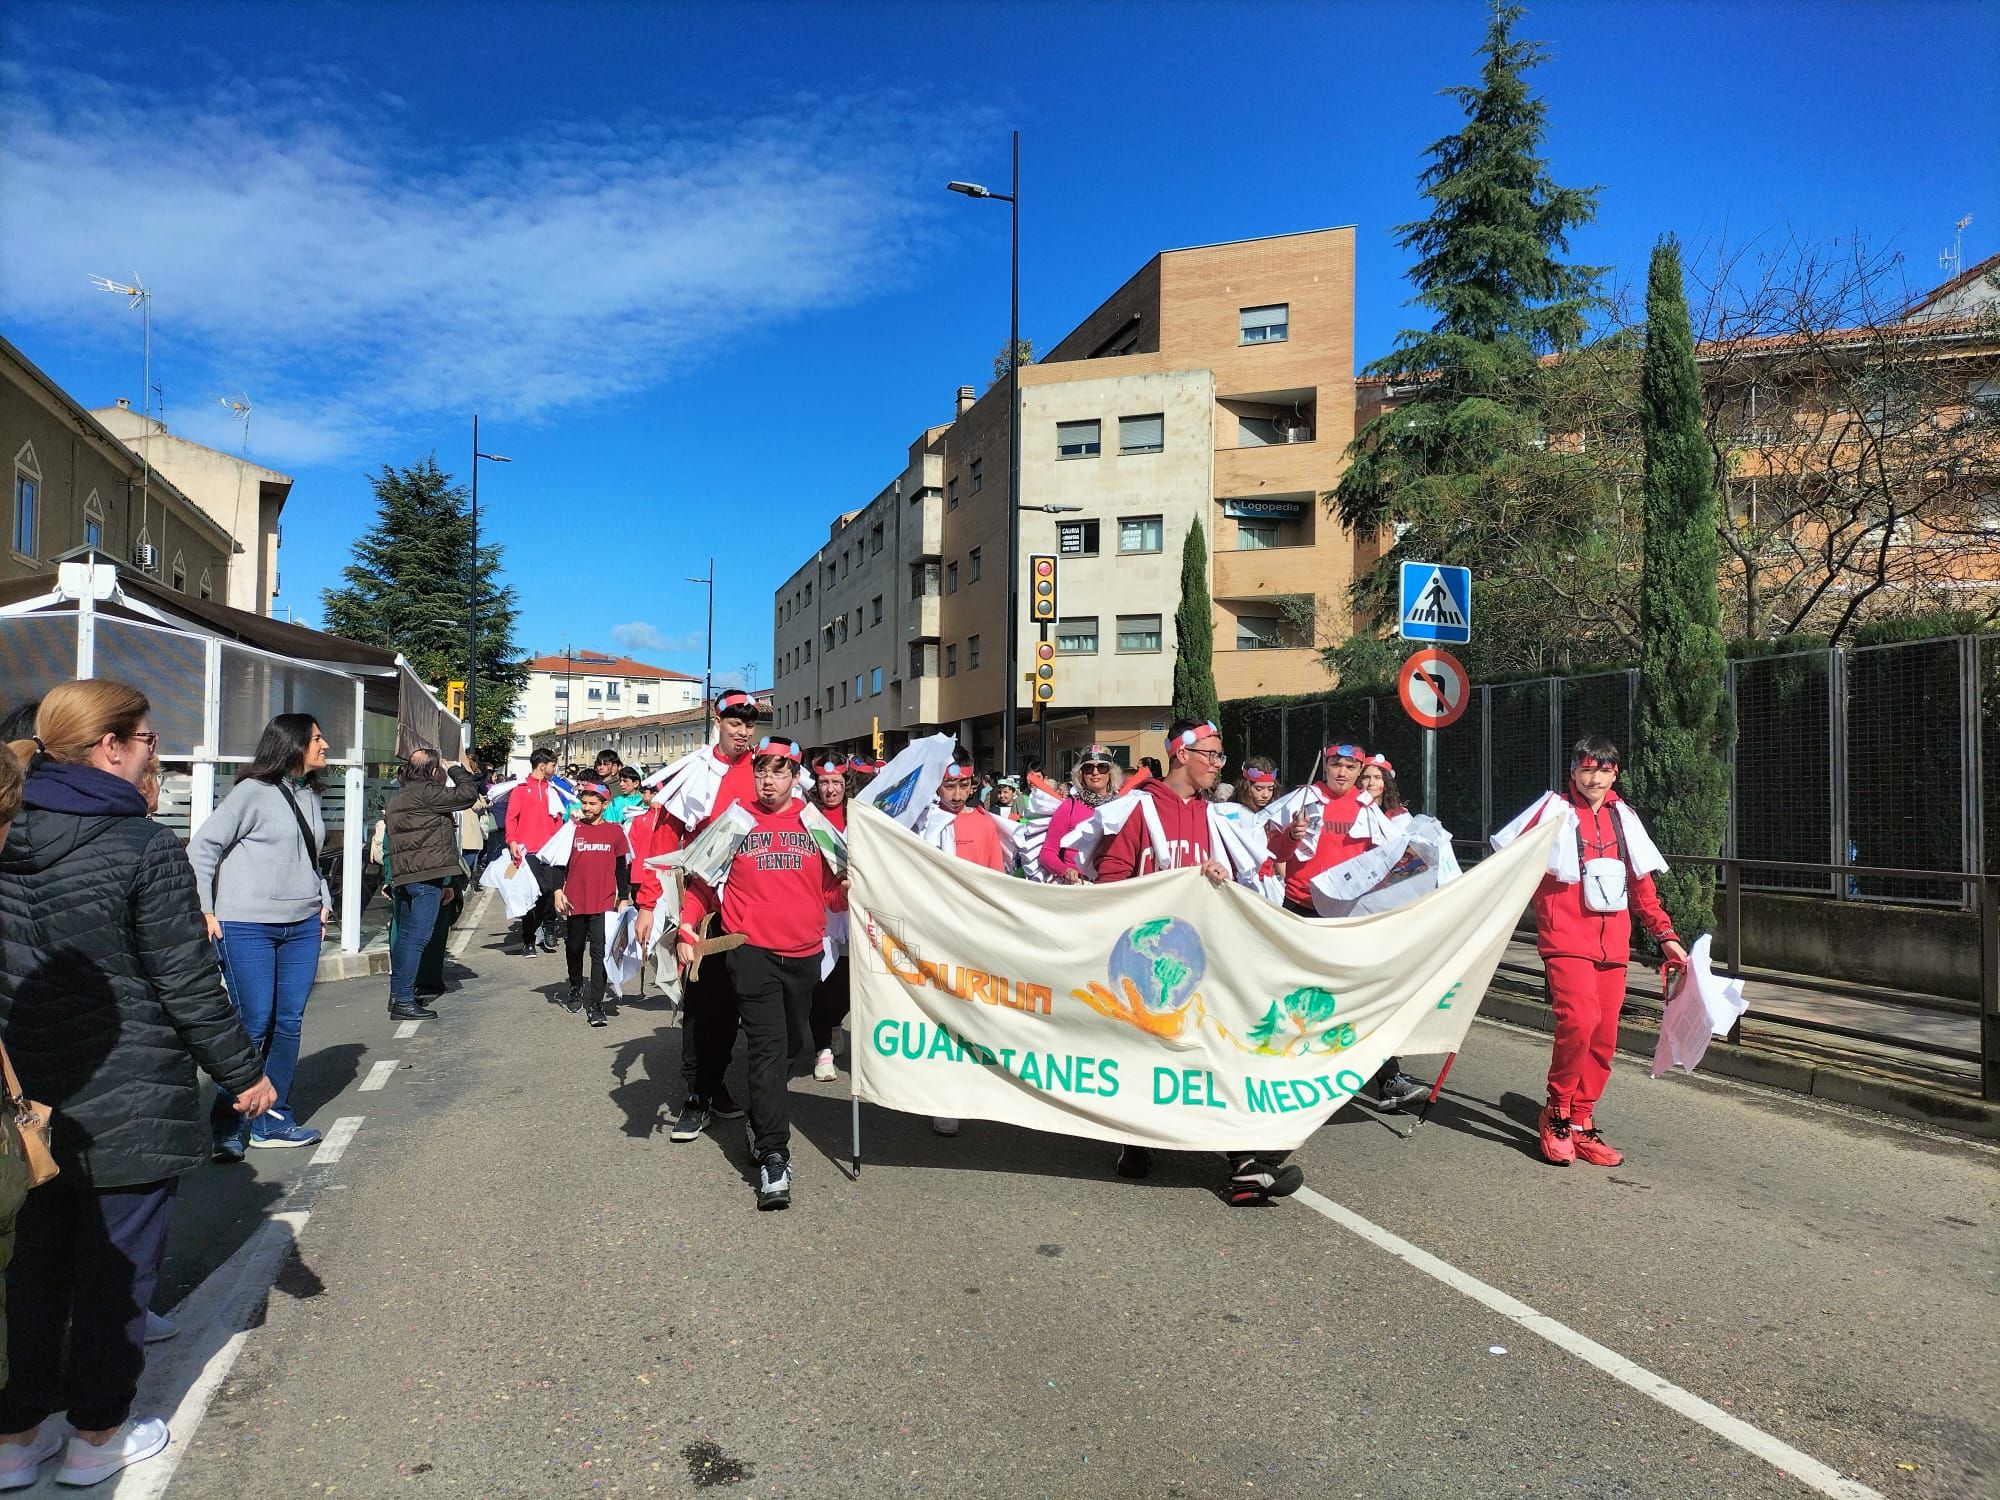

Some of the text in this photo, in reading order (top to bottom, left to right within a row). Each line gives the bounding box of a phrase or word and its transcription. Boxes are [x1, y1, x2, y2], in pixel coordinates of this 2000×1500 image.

[1241, 500, 1299, 511] Logopedia
[1324, 820, 1354, 834] PUM
[739, 831, 817, 857] NEW YORK
[755, 853, 802, 871] TENTH
[873, 1019, 1365, 1114] GUARDIANES DEL MEDIO
